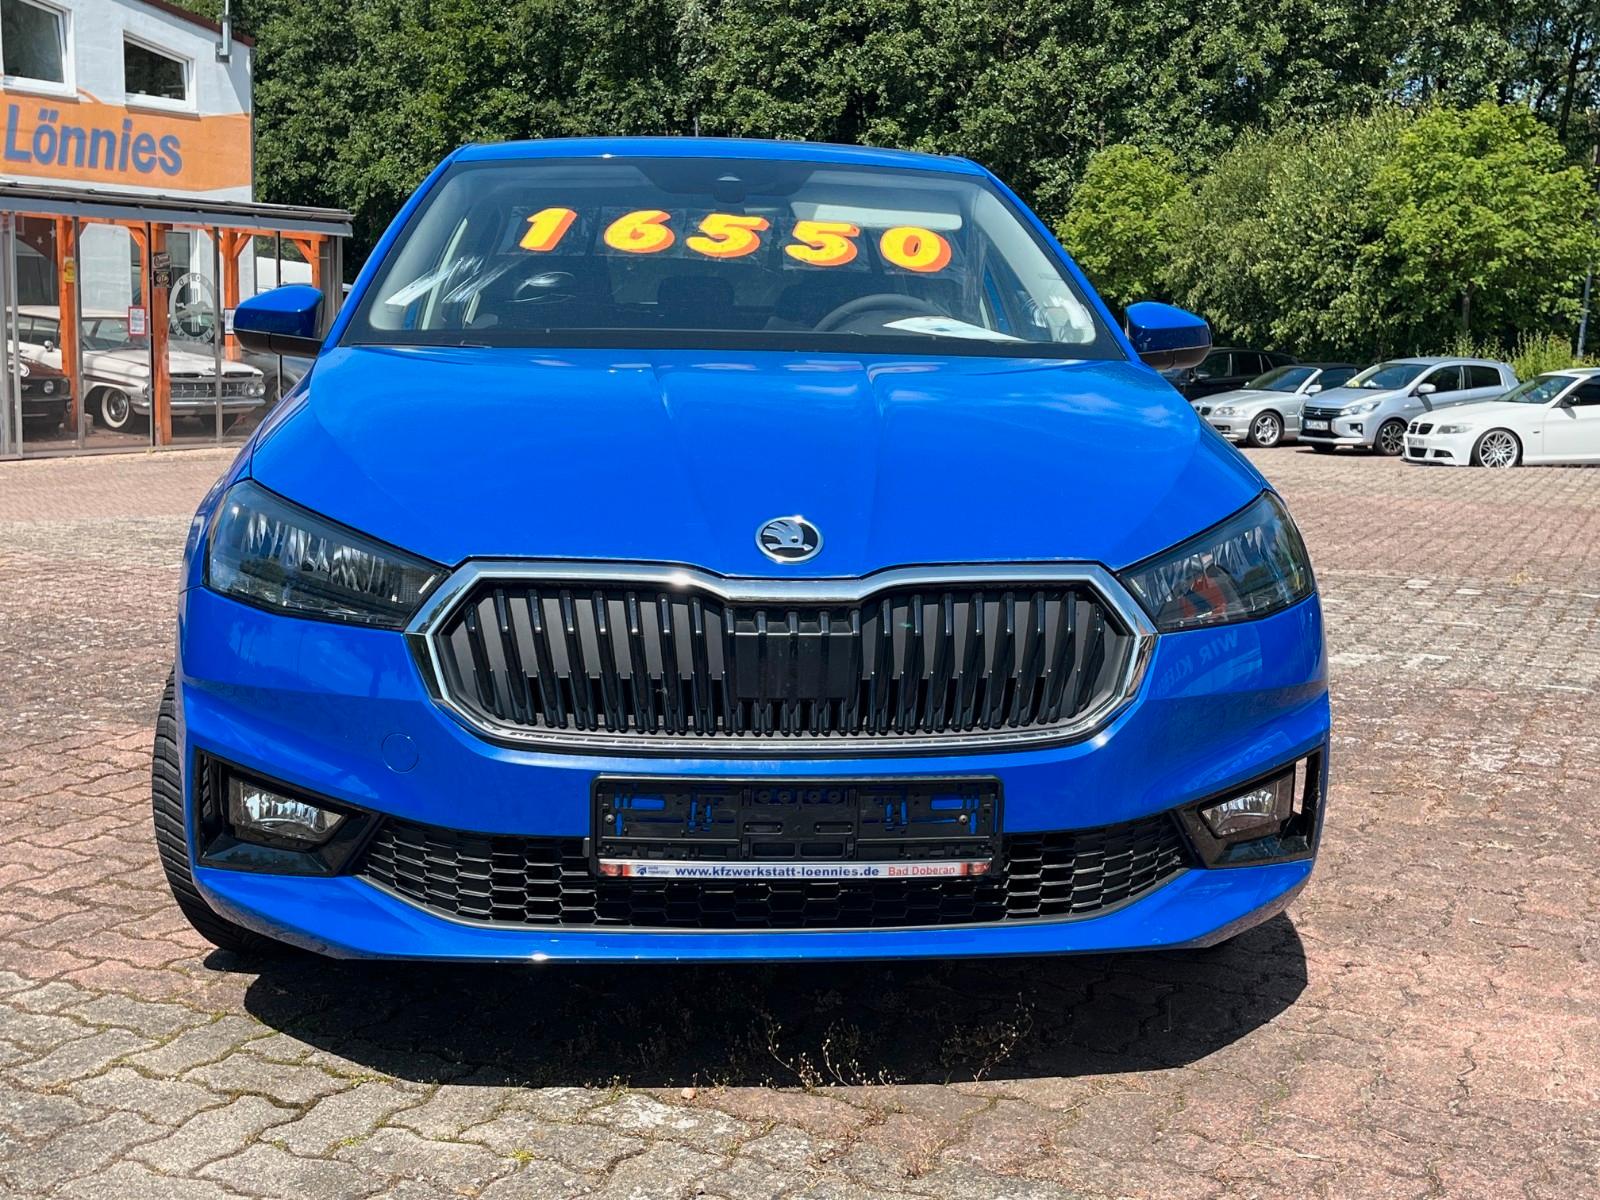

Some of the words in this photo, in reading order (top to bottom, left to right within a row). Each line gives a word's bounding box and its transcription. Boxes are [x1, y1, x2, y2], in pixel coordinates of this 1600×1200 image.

[4, 104, 183, 176] Lönnies
[674, 866, 880, 878] www.kfzwerkstatt-loennies.de
[888, 866, 909, 876] Bad
[911, 866, 955, 876] Doberan
